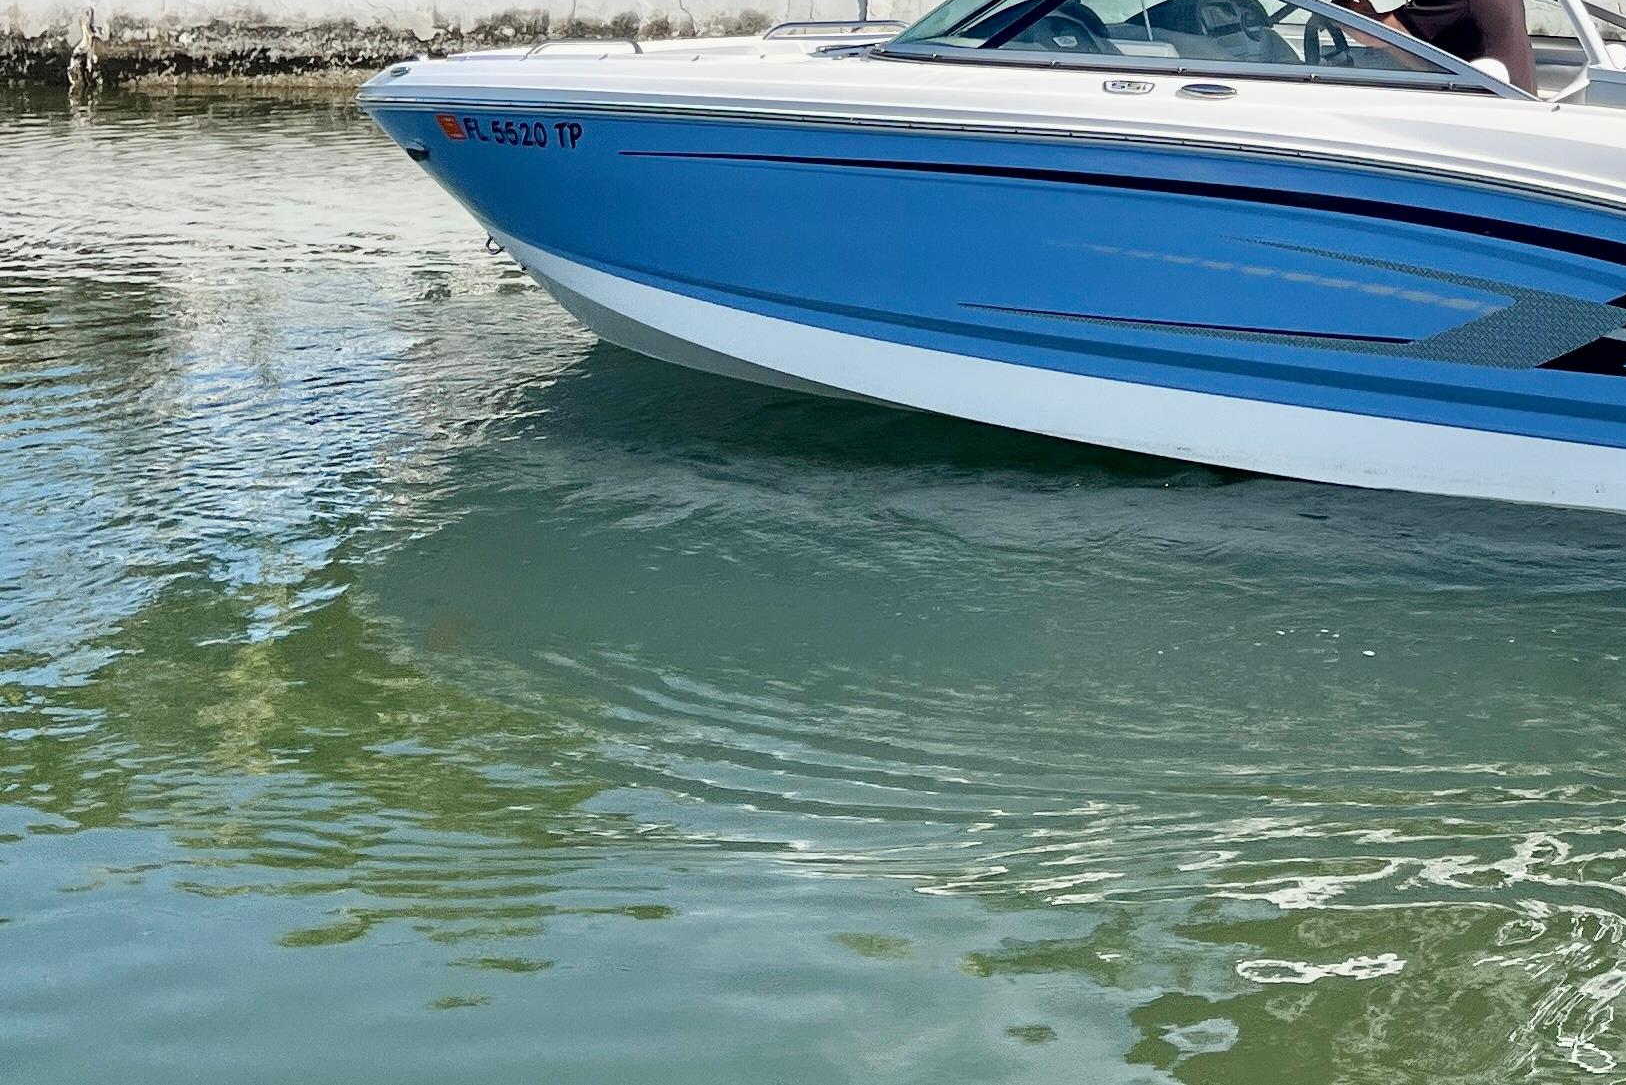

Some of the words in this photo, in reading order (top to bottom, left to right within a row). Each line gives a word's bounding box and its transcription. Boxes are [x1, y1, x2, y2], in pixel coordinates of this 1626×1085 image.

[463, 117, 489, 141] FL
[491, 120, 548, 147] 5520
[554, 121, 583, 148] TP
